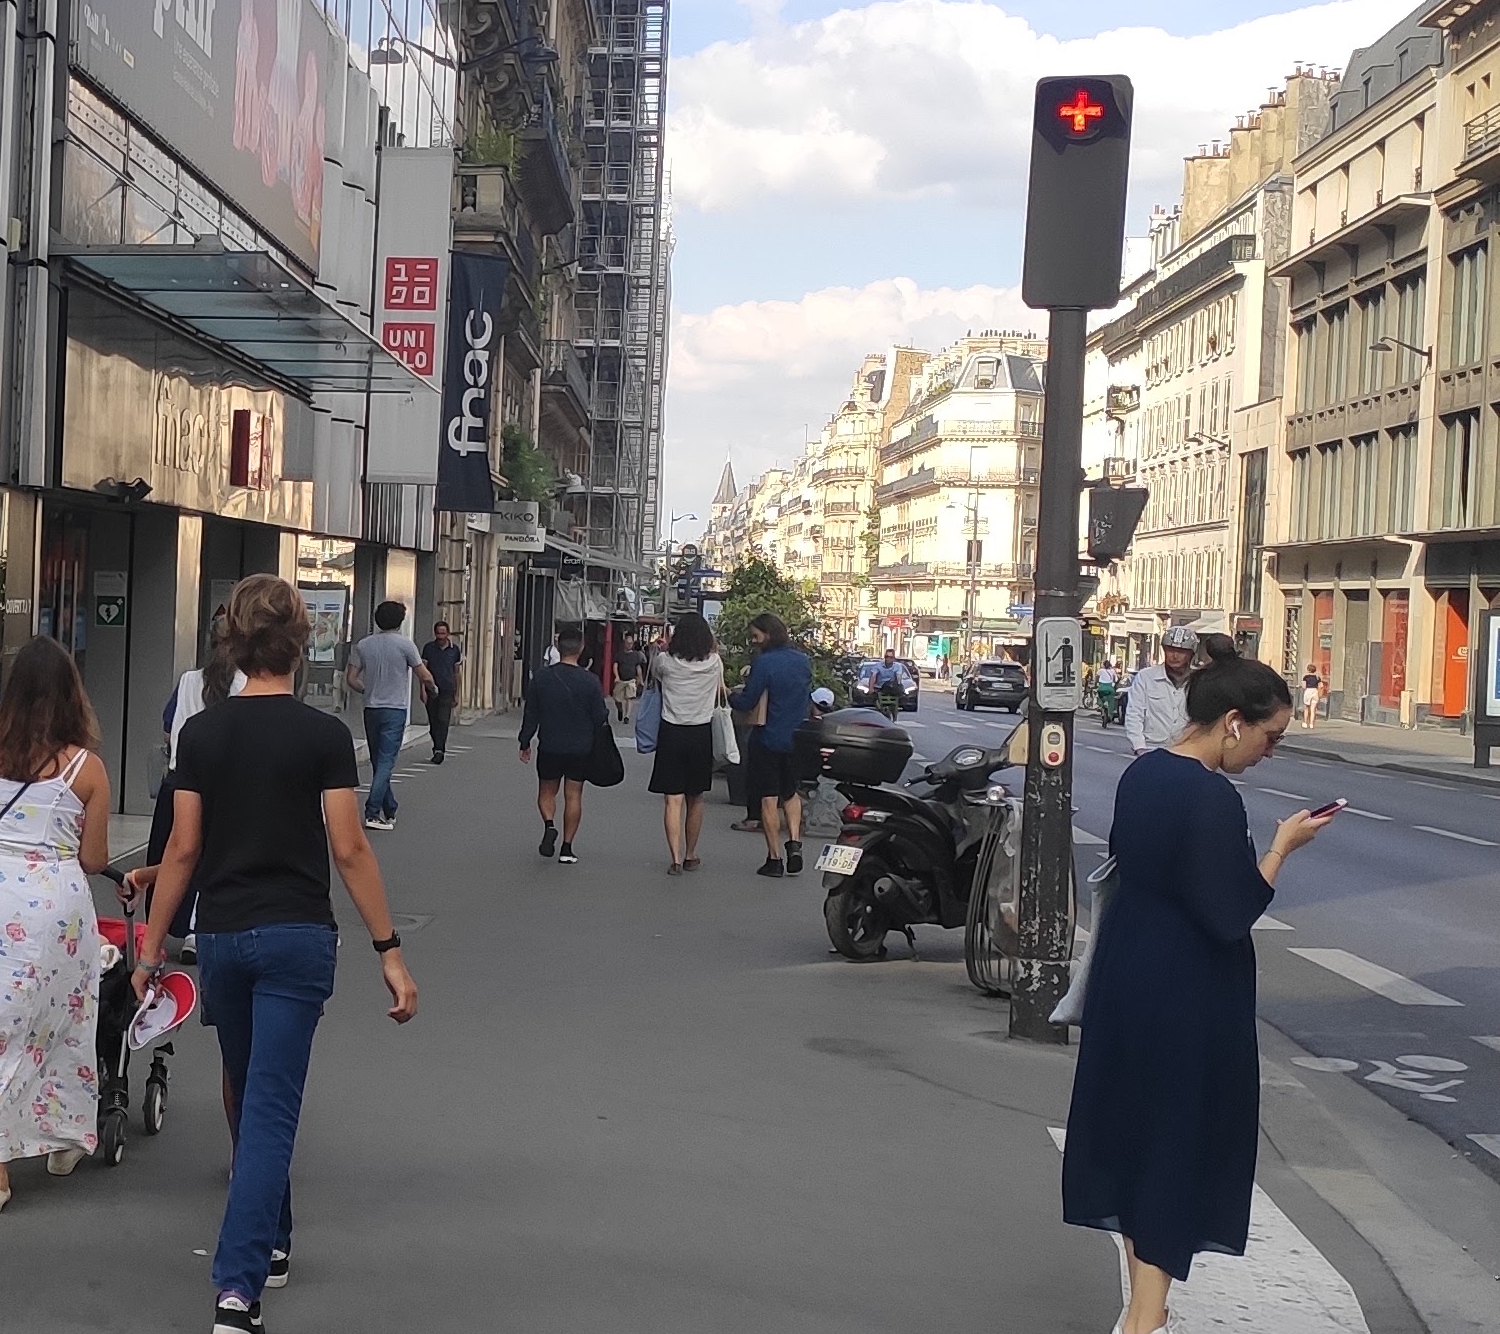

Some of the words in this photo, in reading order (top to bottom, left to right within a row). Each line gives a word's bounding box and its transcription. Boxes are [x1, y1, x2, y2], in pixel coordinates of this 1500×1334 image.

[389, 329, 425, 347] UNI
[448, 309, 493, 456] fnac
[501, 512, 534, 522] KIKO
